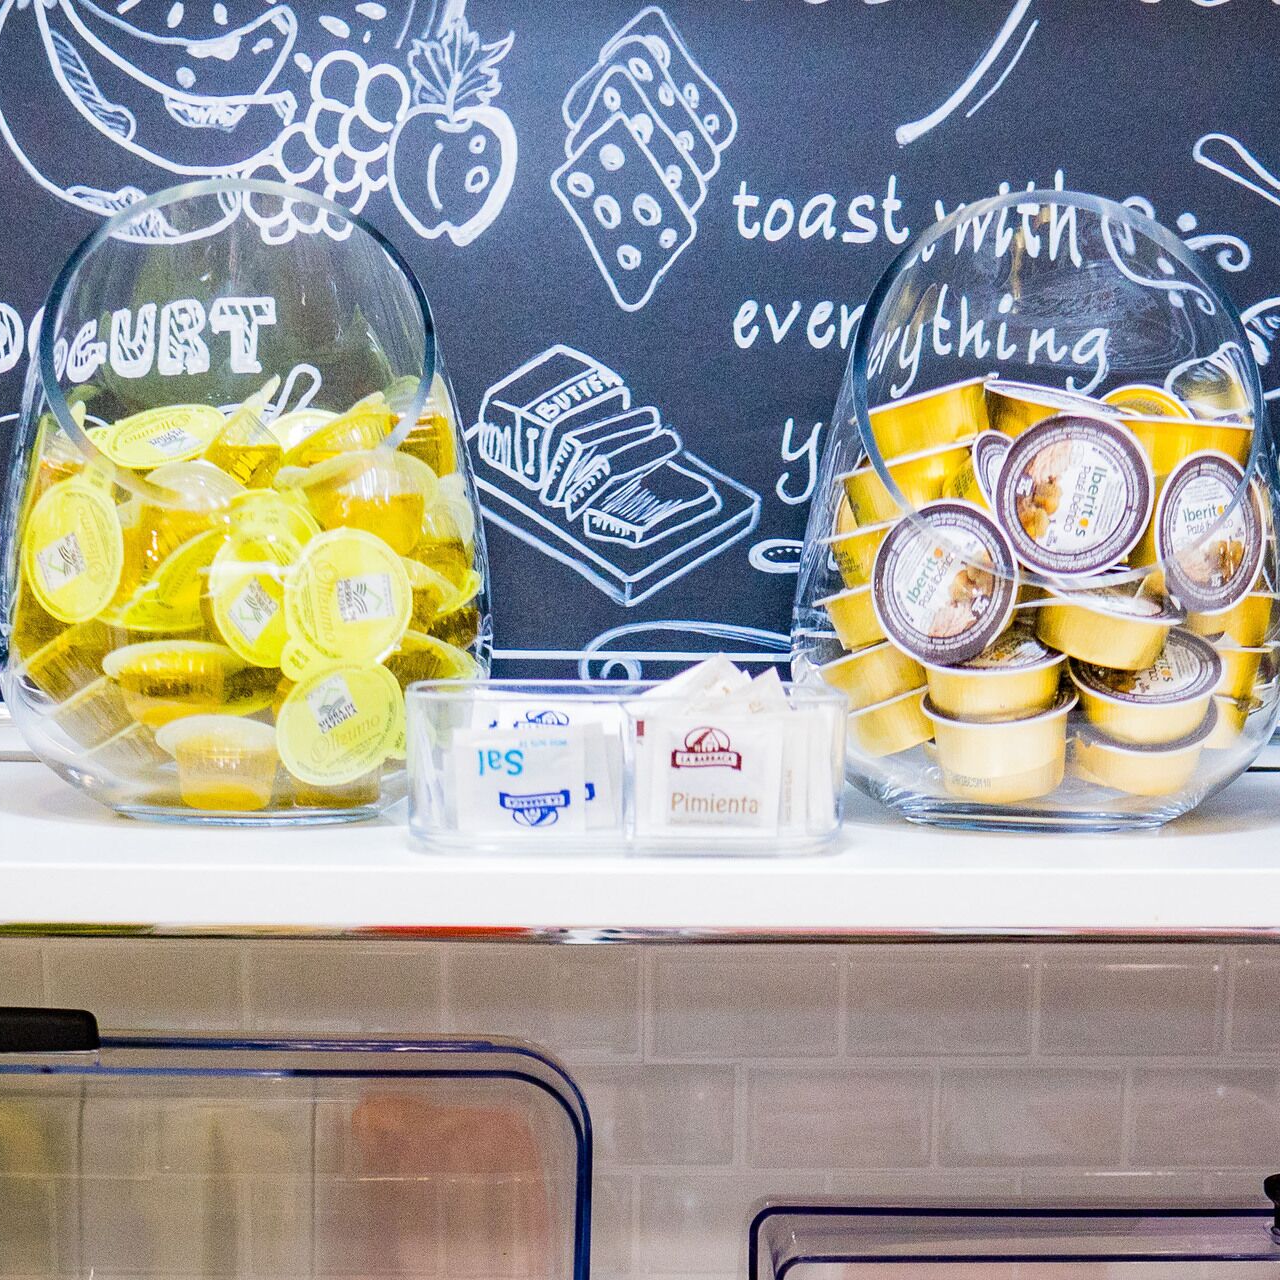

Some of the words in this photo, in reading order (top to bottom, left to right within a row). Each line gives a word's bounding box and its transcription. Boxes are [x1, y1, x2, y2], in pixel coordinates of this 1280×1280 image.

[732, 175, 909, 244] toast
[934, 169, 1082, 268] with
[733, 283, 1111, 398] everything
[535, 371, 617, 421] BUTTER
[1075, 465, 1108, 538] Iberitos
[478, 749, 524, 776] Sal
[671, 792, 759, 814] Pimienta
